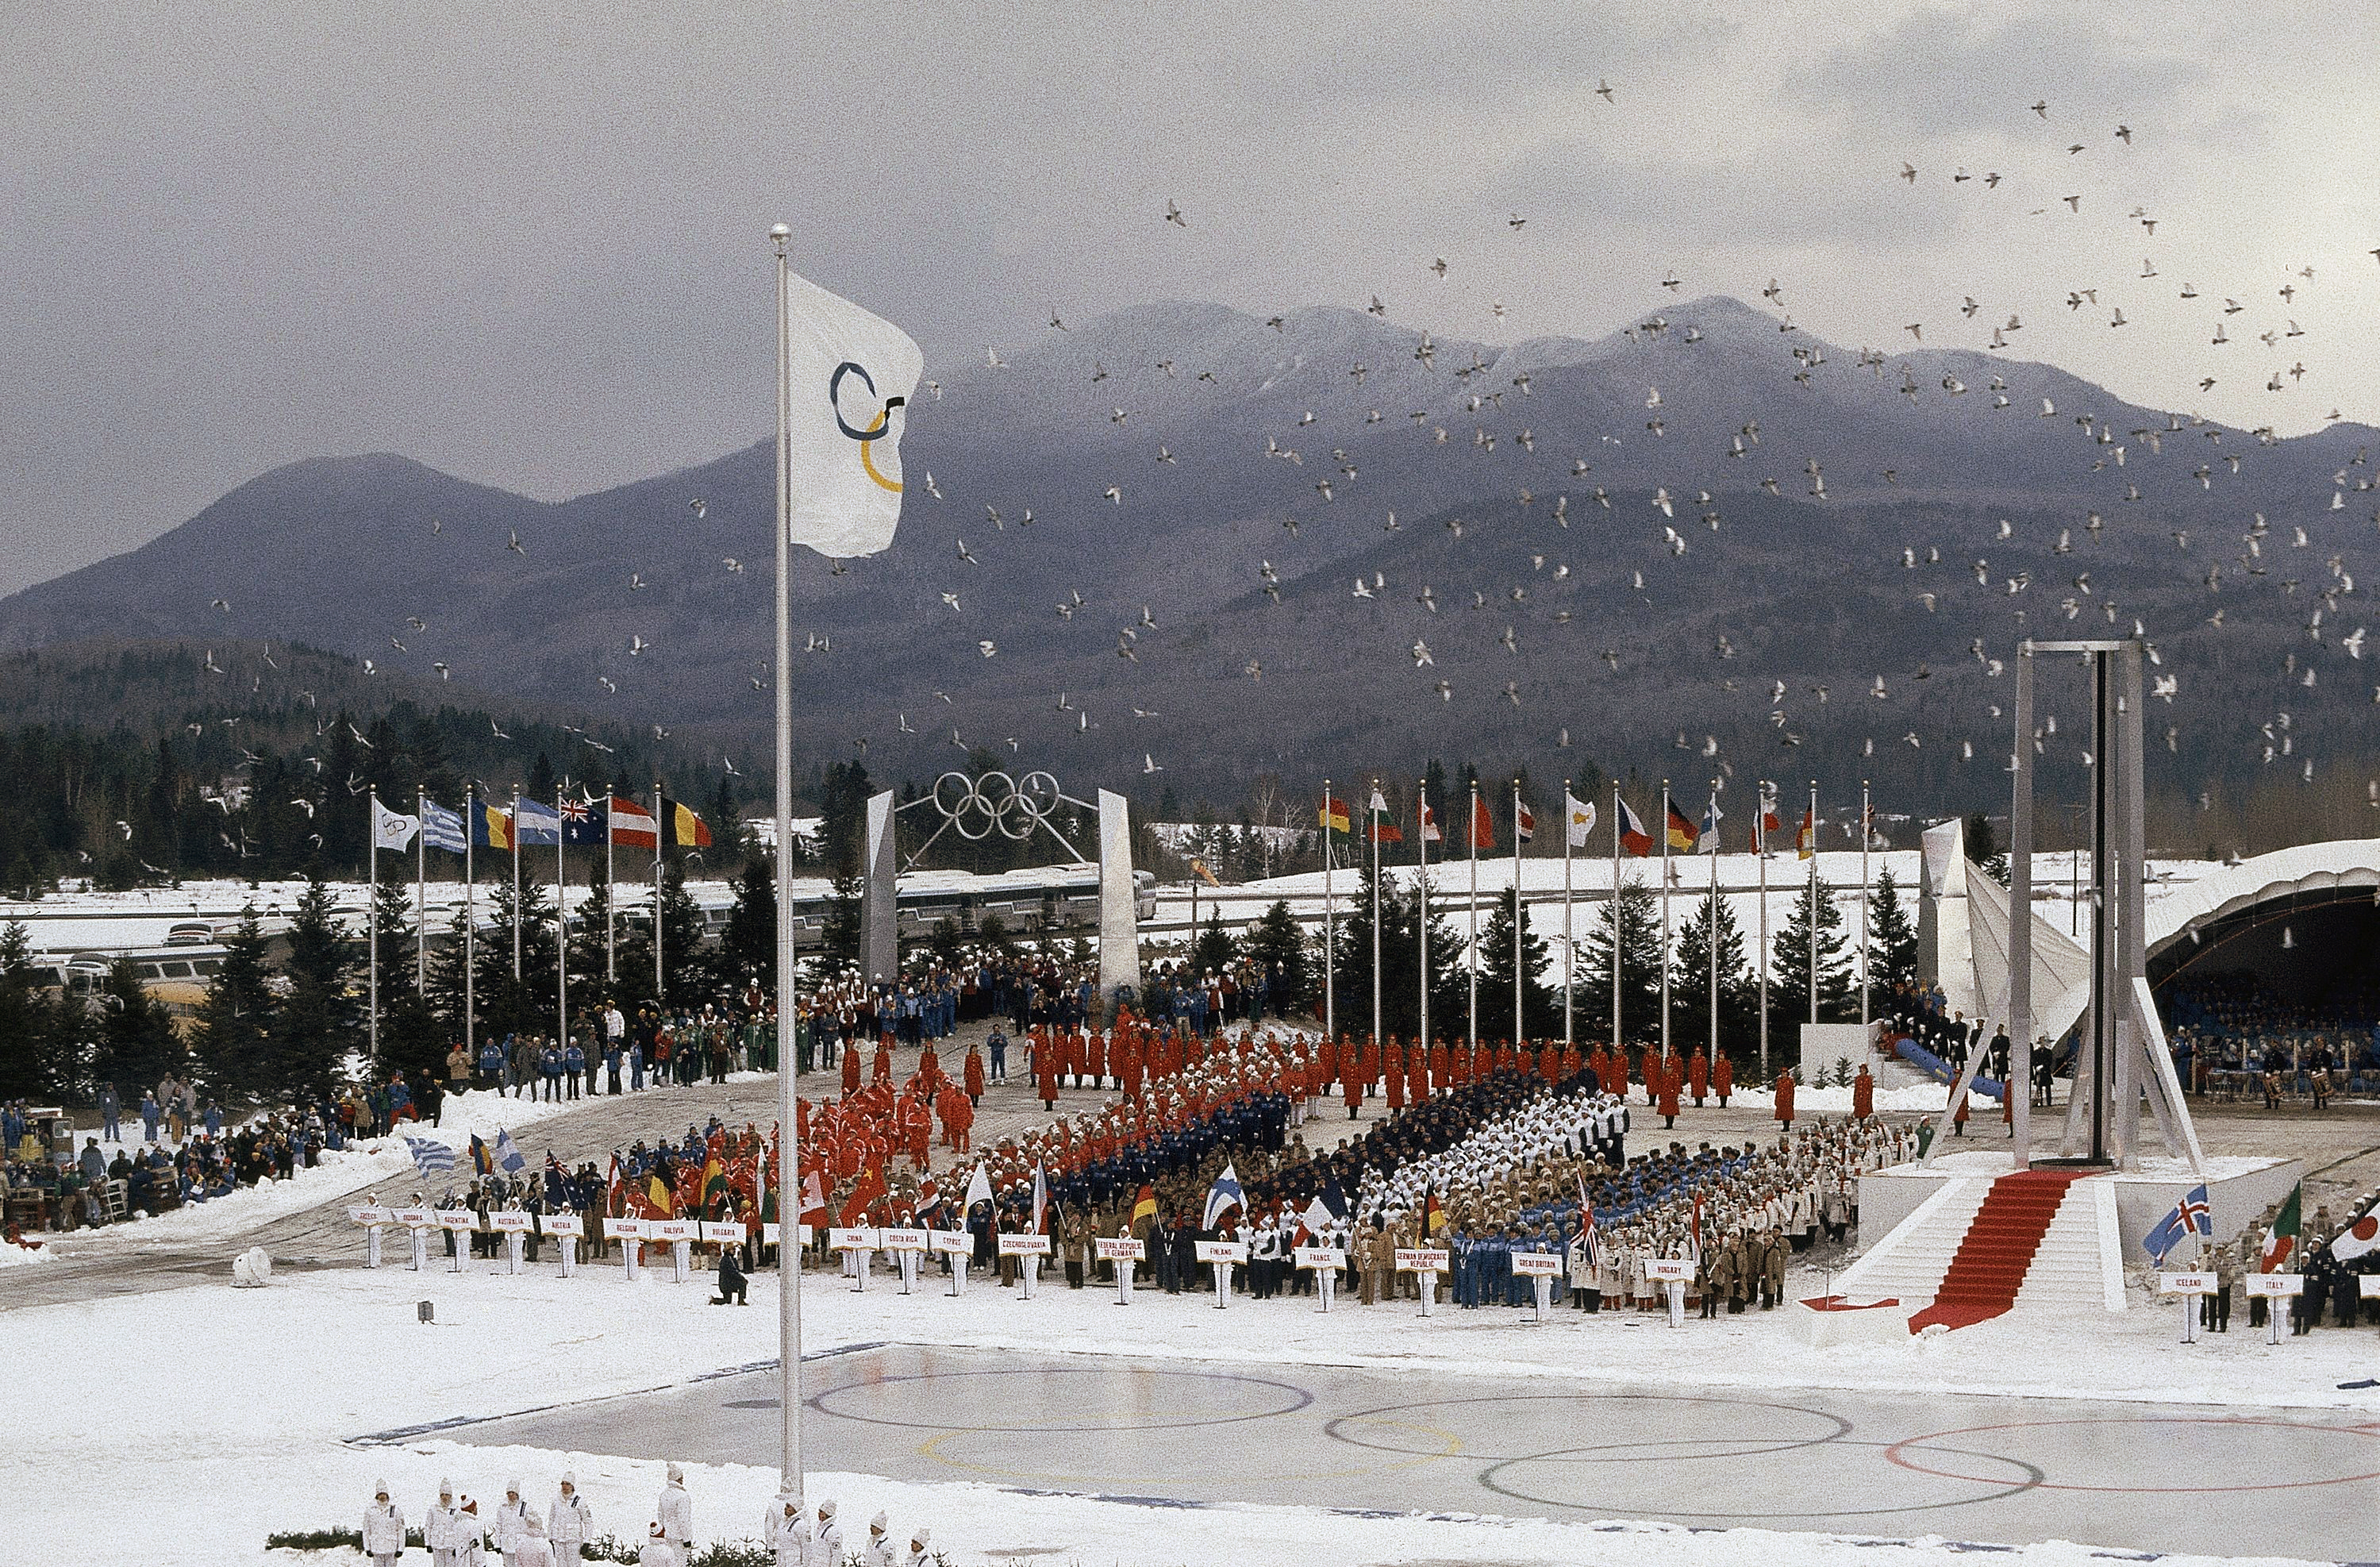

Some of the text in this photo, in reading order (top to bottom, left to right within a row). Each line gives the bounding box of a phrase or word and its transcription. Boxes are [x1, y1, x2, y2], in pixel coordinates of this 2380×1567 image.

[944, 1237, 961, 1246] CYPRUS
[1002, 1240, 1046, 1249] CZECHOSLOVAKIA
[1417, 1252, 1447, 1261] DEMOCRATIC
[1536, 1260, 1555, 1269] BRITAIN
[1657, 1265, 1682, 1274] HUNGARY
[2176, 1279, 2201, 1288] ICELAND
[2266, 1280, 2283, 1290] ITALY
